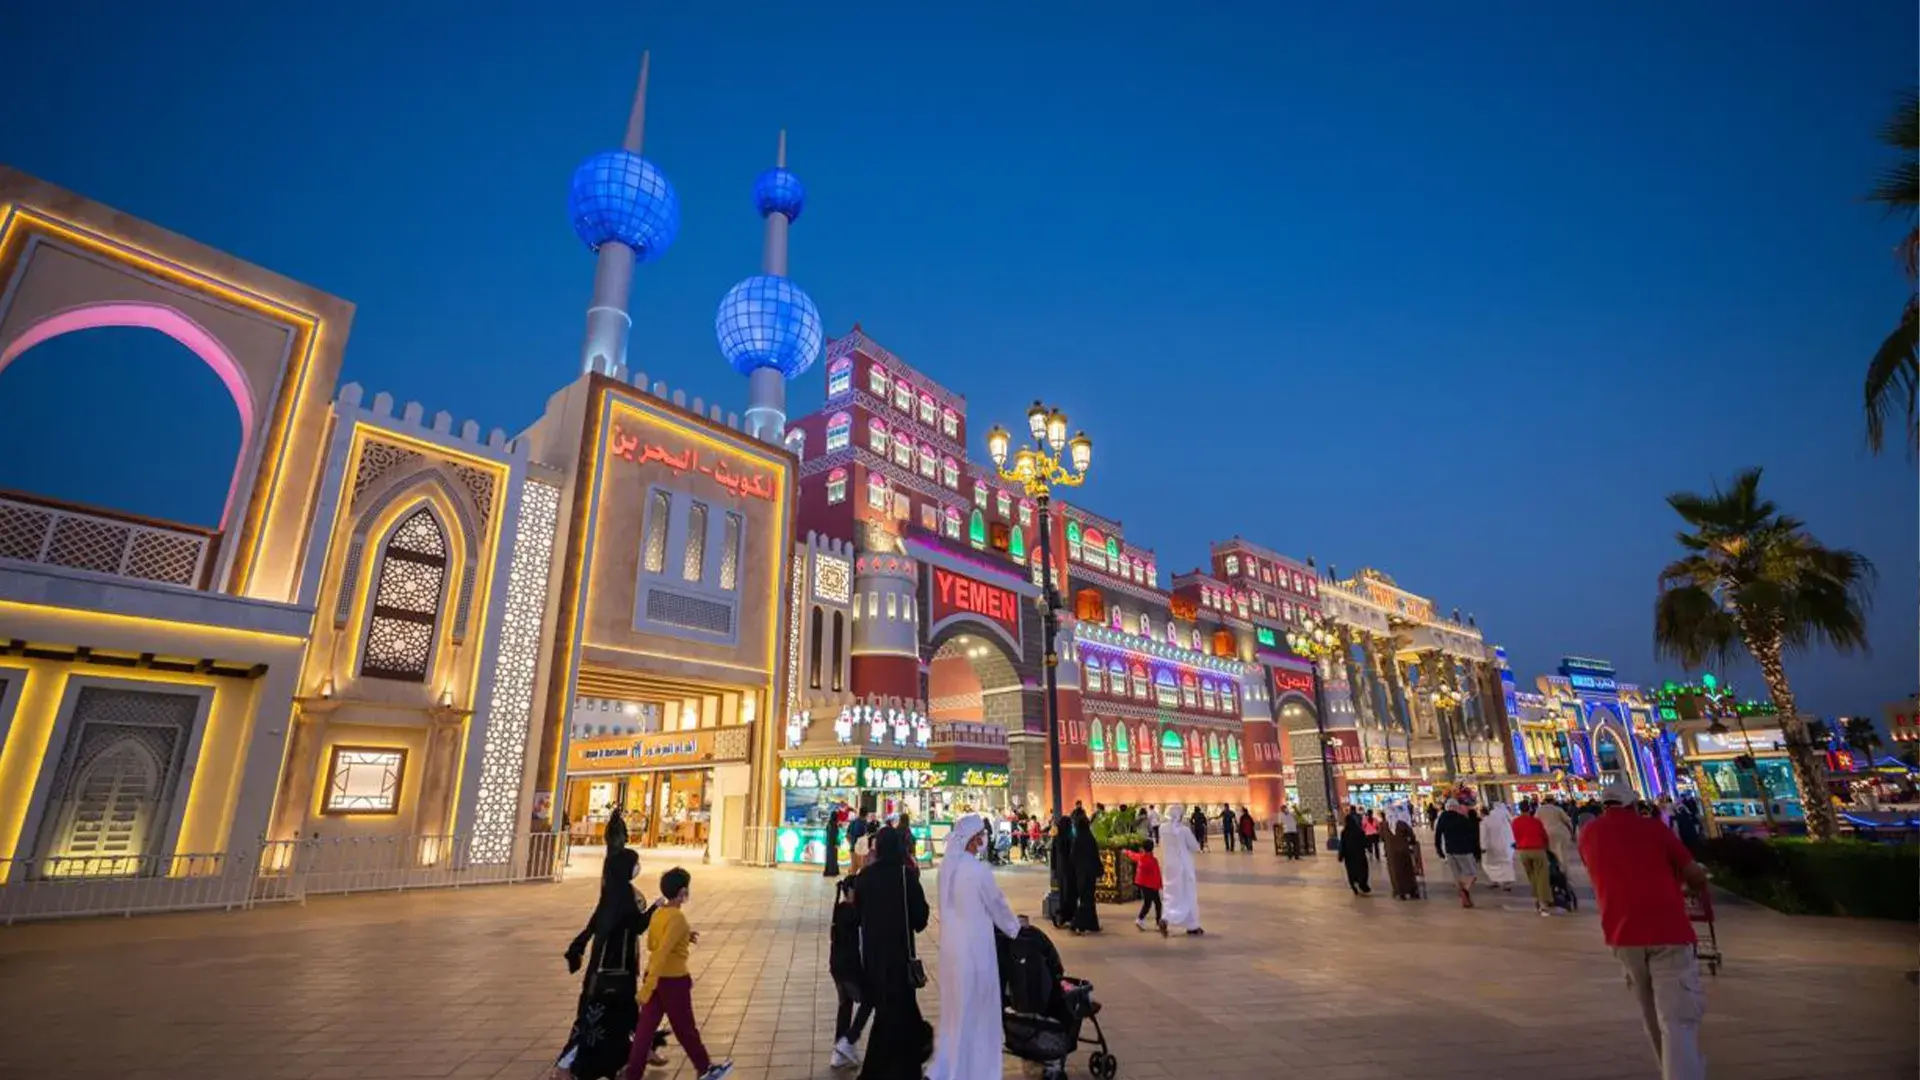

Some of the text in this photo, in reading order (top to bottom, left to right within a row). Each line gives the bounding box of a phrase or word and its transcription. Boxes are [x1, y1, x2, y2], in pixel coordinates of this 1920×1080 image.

[611, 425, 698, 477] البحرين
[936, 569, 1017, 623] YEMEN
[1275, 672, 1313, 692] اليمن
[784, 758, 815, 769] TURKISH
[827, 757, 852, 767] CREAM
[869, 758, 898, 769] TURKISH
[909, 759, 931, 769] CREAM
